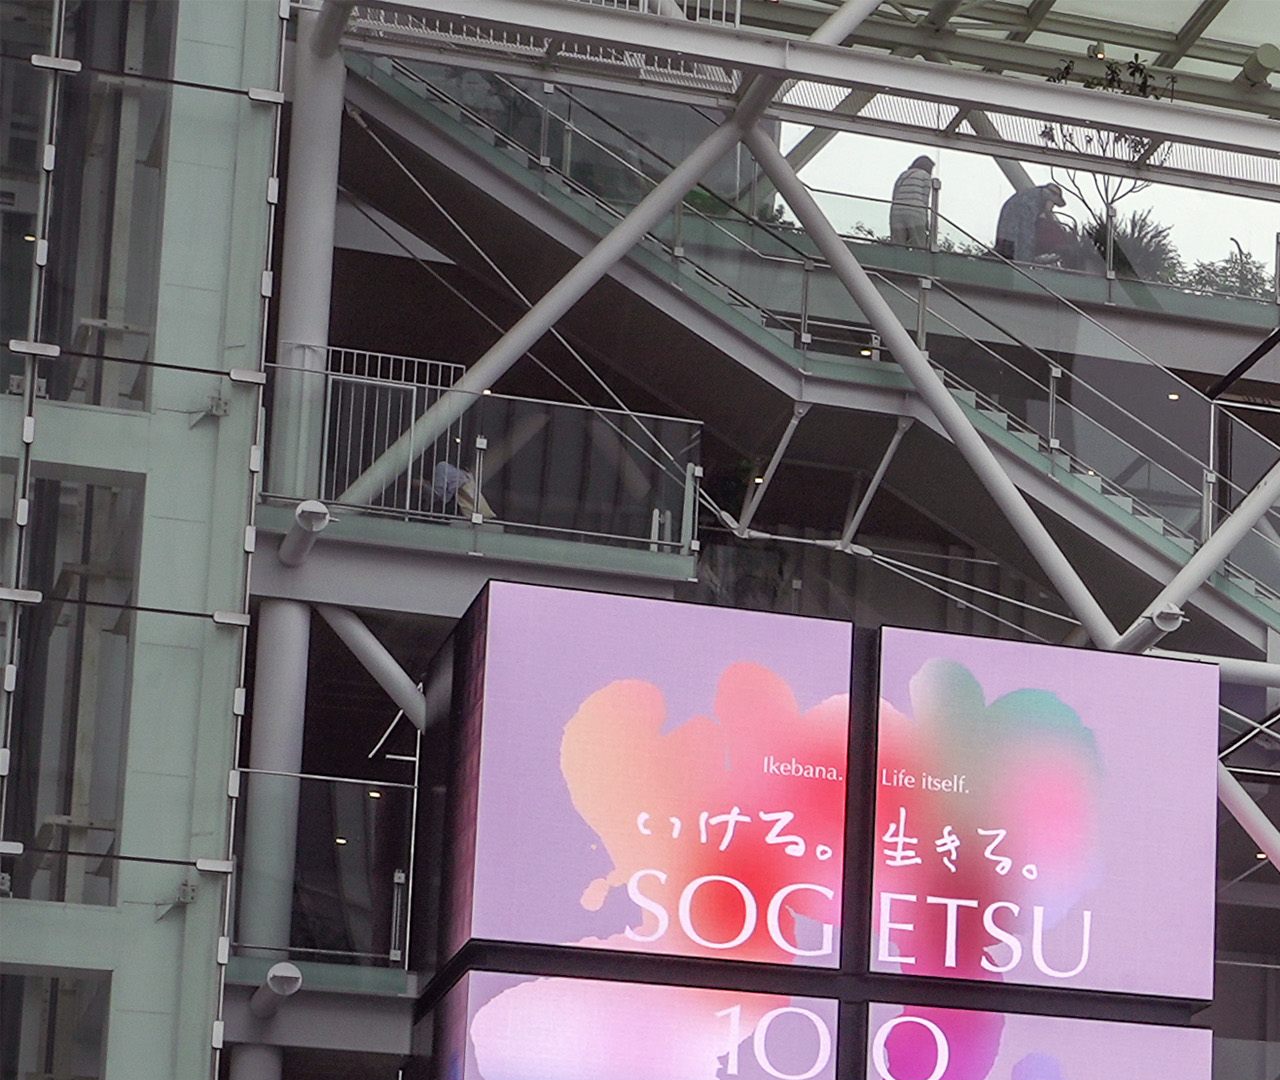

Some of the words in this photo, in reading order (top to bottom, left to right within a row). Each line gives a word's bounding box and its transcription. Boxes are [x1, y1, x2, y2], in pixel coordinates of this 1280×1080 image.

[763, 756, 844, 781] Ikebana.
[881, 768, 916, 788] Life
[921, 772, 970, 794] itself.
